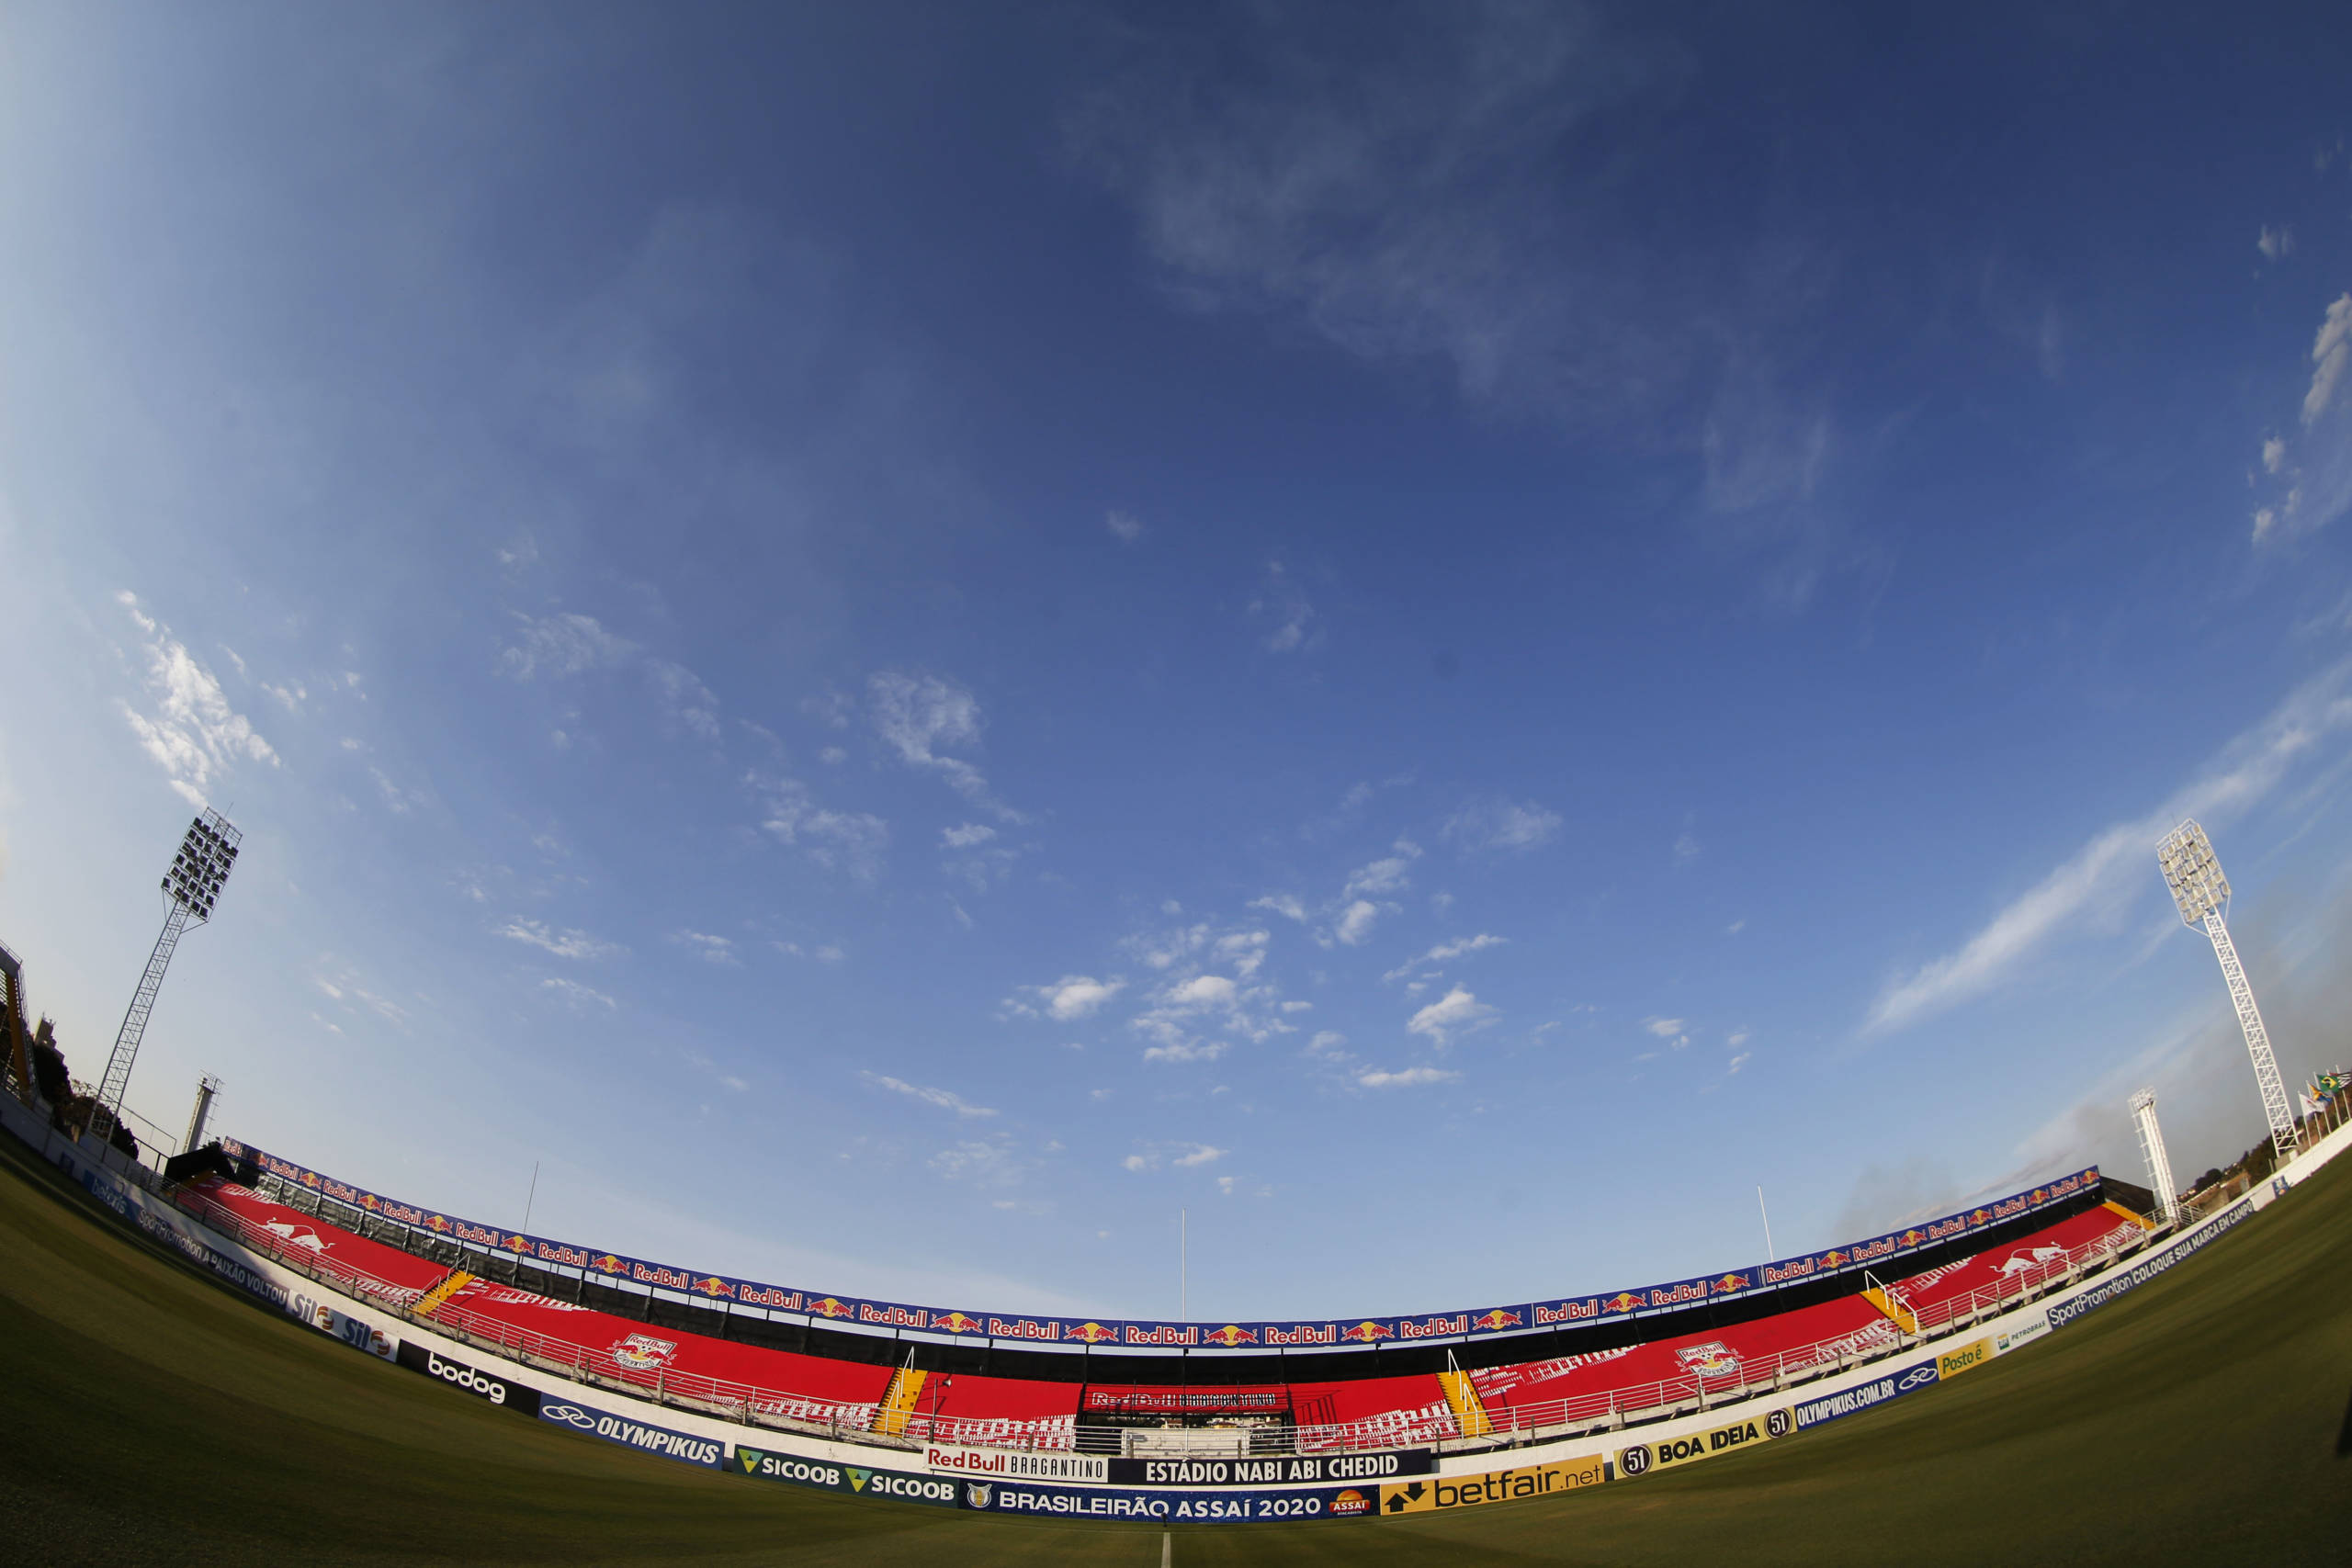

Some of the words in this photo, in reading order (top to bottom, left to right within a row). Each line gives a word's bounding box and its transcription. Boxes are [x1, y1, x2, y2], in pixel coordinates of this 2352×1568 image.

[2132, 1251, 2176, 1284] COLOQUE
[2176, 1242, 2194, 1261] SUA
[2191, 1224, 2221, 1250] MARCA
[2218, 1215, 2231, 1232] EM
[2229, 1201, 2253, 1224] CAMPO
[247, 1273, 288, 1305] VOLTOU
[2049, 1275, 2133, 1325] SportPromotion
[2011, 1320, 2046, 1341] PETROBRAS
[1942, 1352, 1974, 1374] Posto
[427, 1351, 505, 1404] bodog
[1796, 1379, 1895, 1427] OLYMPIKUS.COM.BR
[1770, 1413, 1786, 1435] 51
[597, 1416, 720, 1465] OLYMPIKUS
[1658, 1438, 1705, 1463] BOA
[1711, 1422, 1759, 1450] IDEIA
[762, 1457, 840, 1486] SICOOB
[1011, 1456, 1102, 1479] BRAGANTINO
[1146, 1457, 1228, 1483] ESTÁDIO
[1235, 1461, 1283, 1482] NABI
[1289, 1460, 1322, 1481] ABI
[1329, 1455, 1398, 1478] CHEDID
[1627, 1449, 1645, 1472] 51
[871, 1475, 956, 1502] SICOOB
[999, 1491, 1170, 1517] BRASILEIRÃO
[1259, 1497, 1321, 1517] 2020
